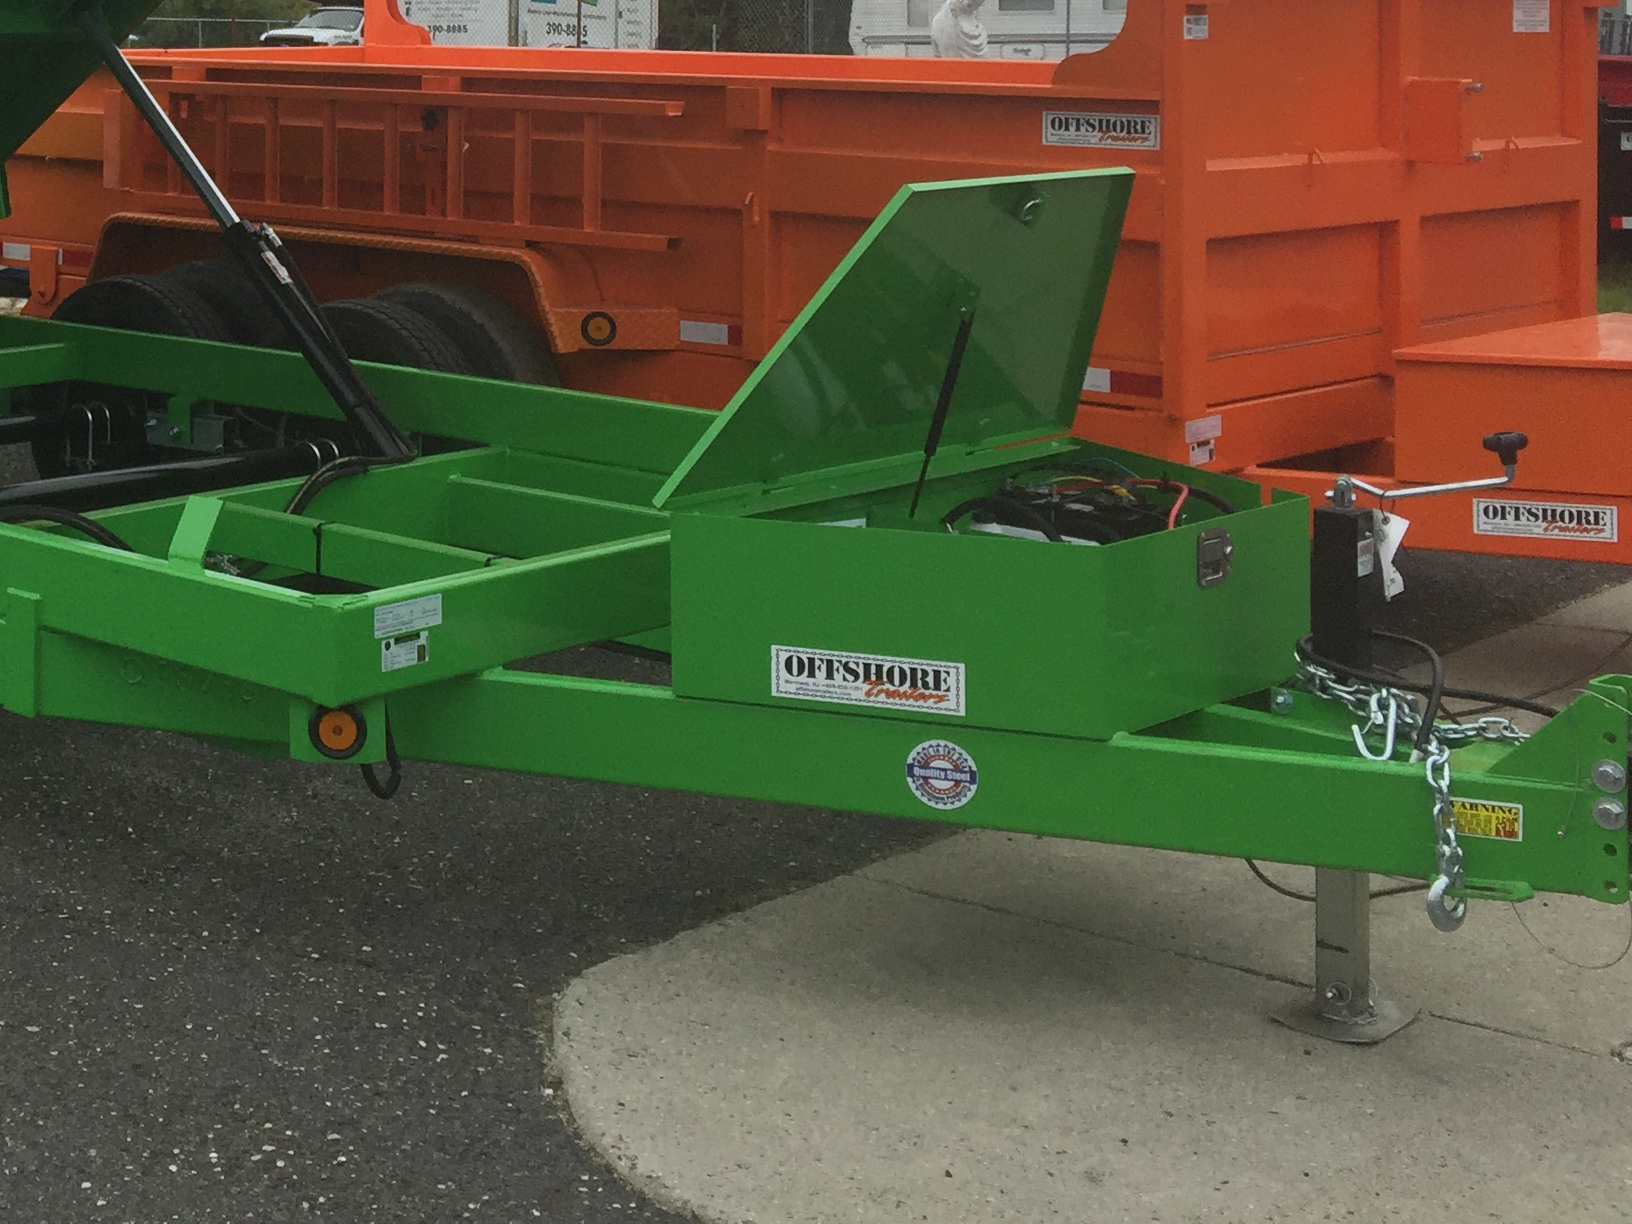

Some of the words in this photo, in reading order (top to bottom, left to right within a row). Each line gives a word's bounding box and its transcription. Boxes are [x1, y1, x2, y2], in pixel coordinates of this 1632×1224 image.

[546, 22, 588, 38] 390-885
[1050, 116, 1152, 136] OFFSHORE
[1482, 504, 1607, 527] OFFSHORE
[784, 654, 951, 693] OFFSHORE
[864, 680, 951, 705] Trailers
[913, 766, 946, 780] Quality
[946, 769, 971, 782] Steel
